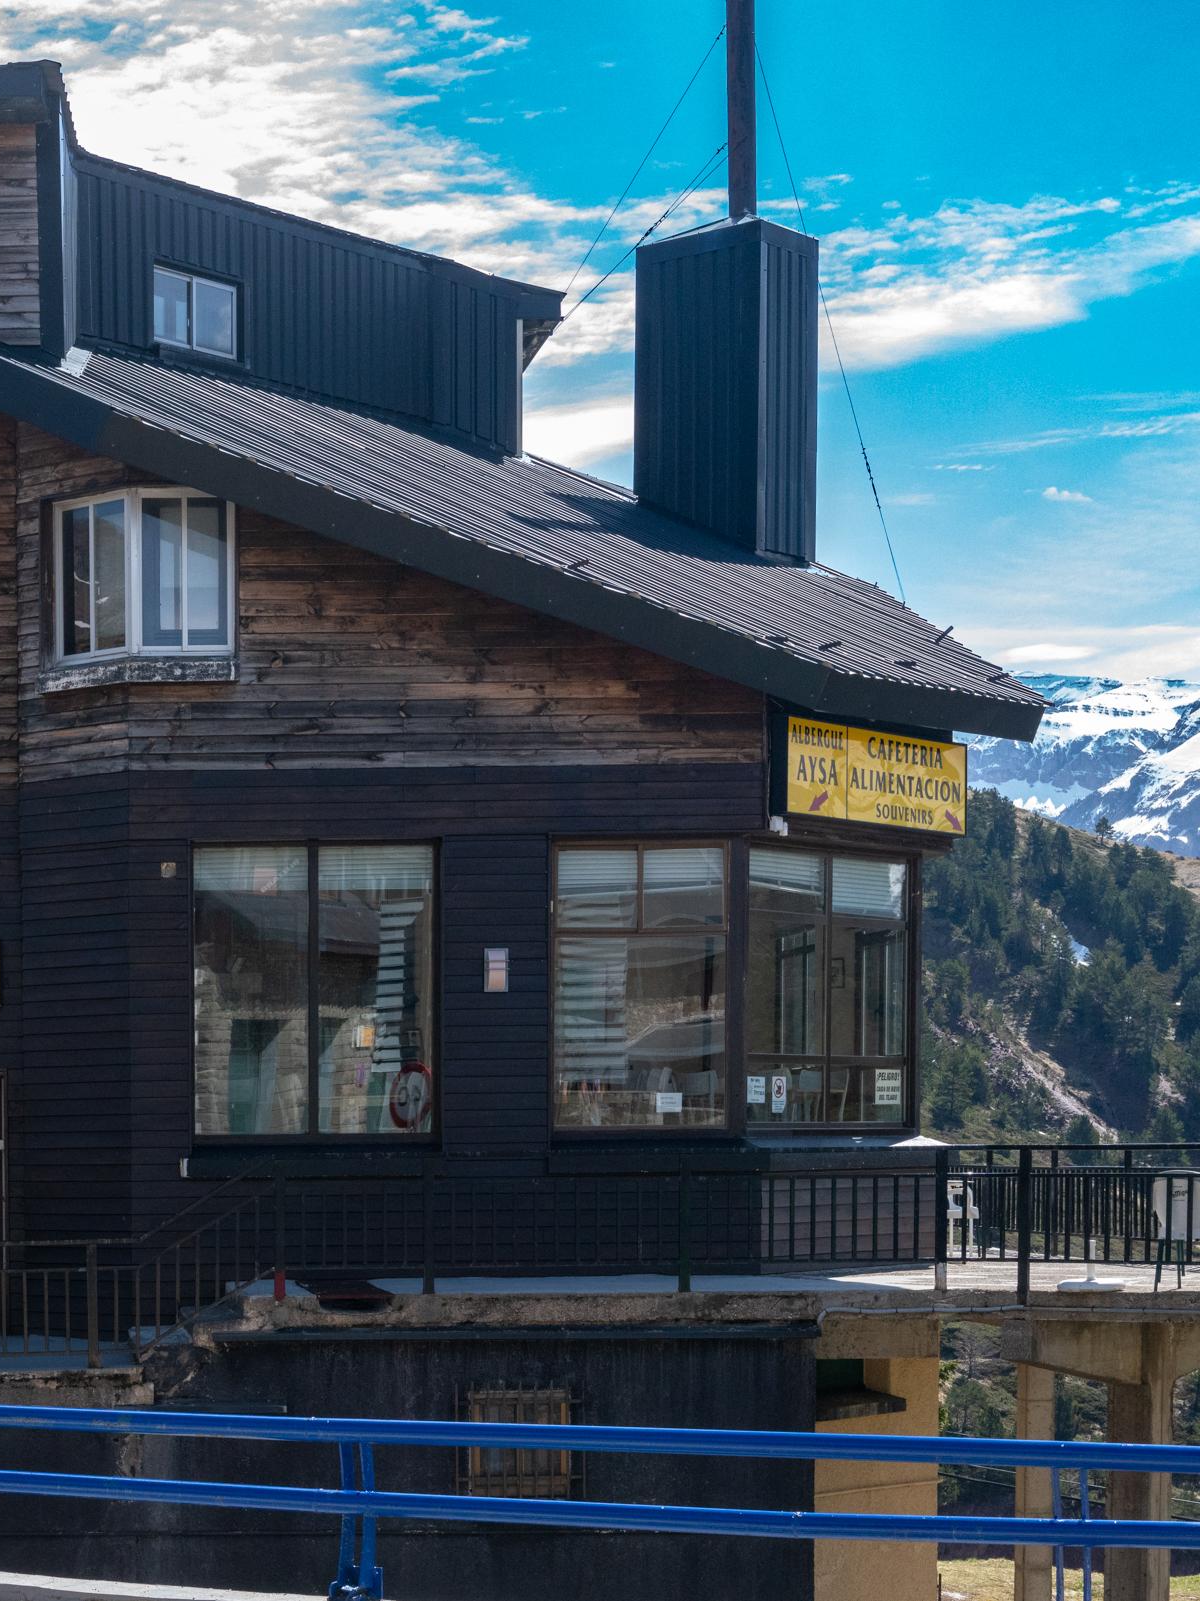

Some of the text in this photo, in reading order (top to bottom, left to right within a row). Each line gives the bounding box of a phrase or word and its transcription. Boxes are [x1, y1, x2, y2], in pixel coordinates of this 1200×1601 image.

[790, 723, 844, 751] ALBERGUE
[867, 736, 943, 769] CAFETERIA
[797, 754, 839, 786] AYSA
[850, 767, 961, 804] ALIMENTACION
[875, 803, 934, 825] SOUVENIRS
